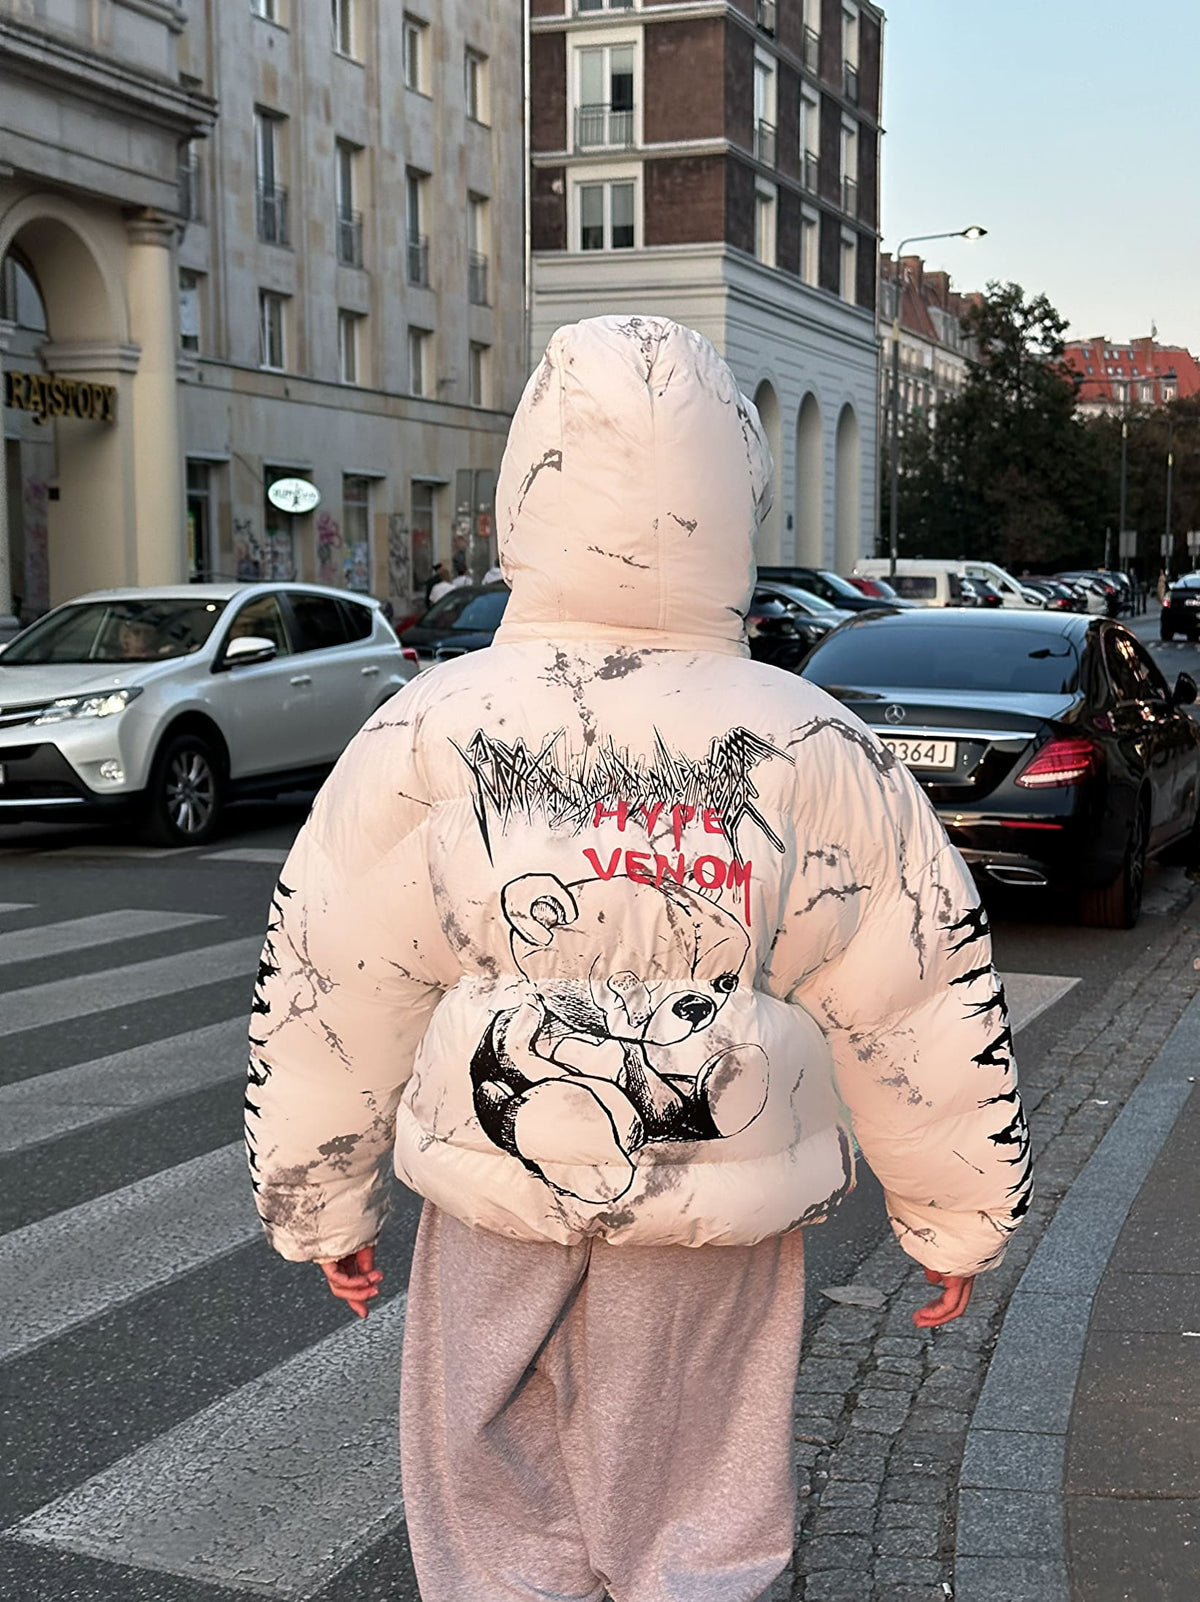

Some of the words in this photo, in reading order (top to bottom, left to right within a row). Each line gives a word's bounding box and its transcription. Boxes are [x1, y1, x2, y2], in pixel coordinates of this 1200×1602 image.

[7, 371, 115, 426] RAJSTOPY
[593, 801, 726, 851] HYPE
[582, 847, 752, 926] VENOM
